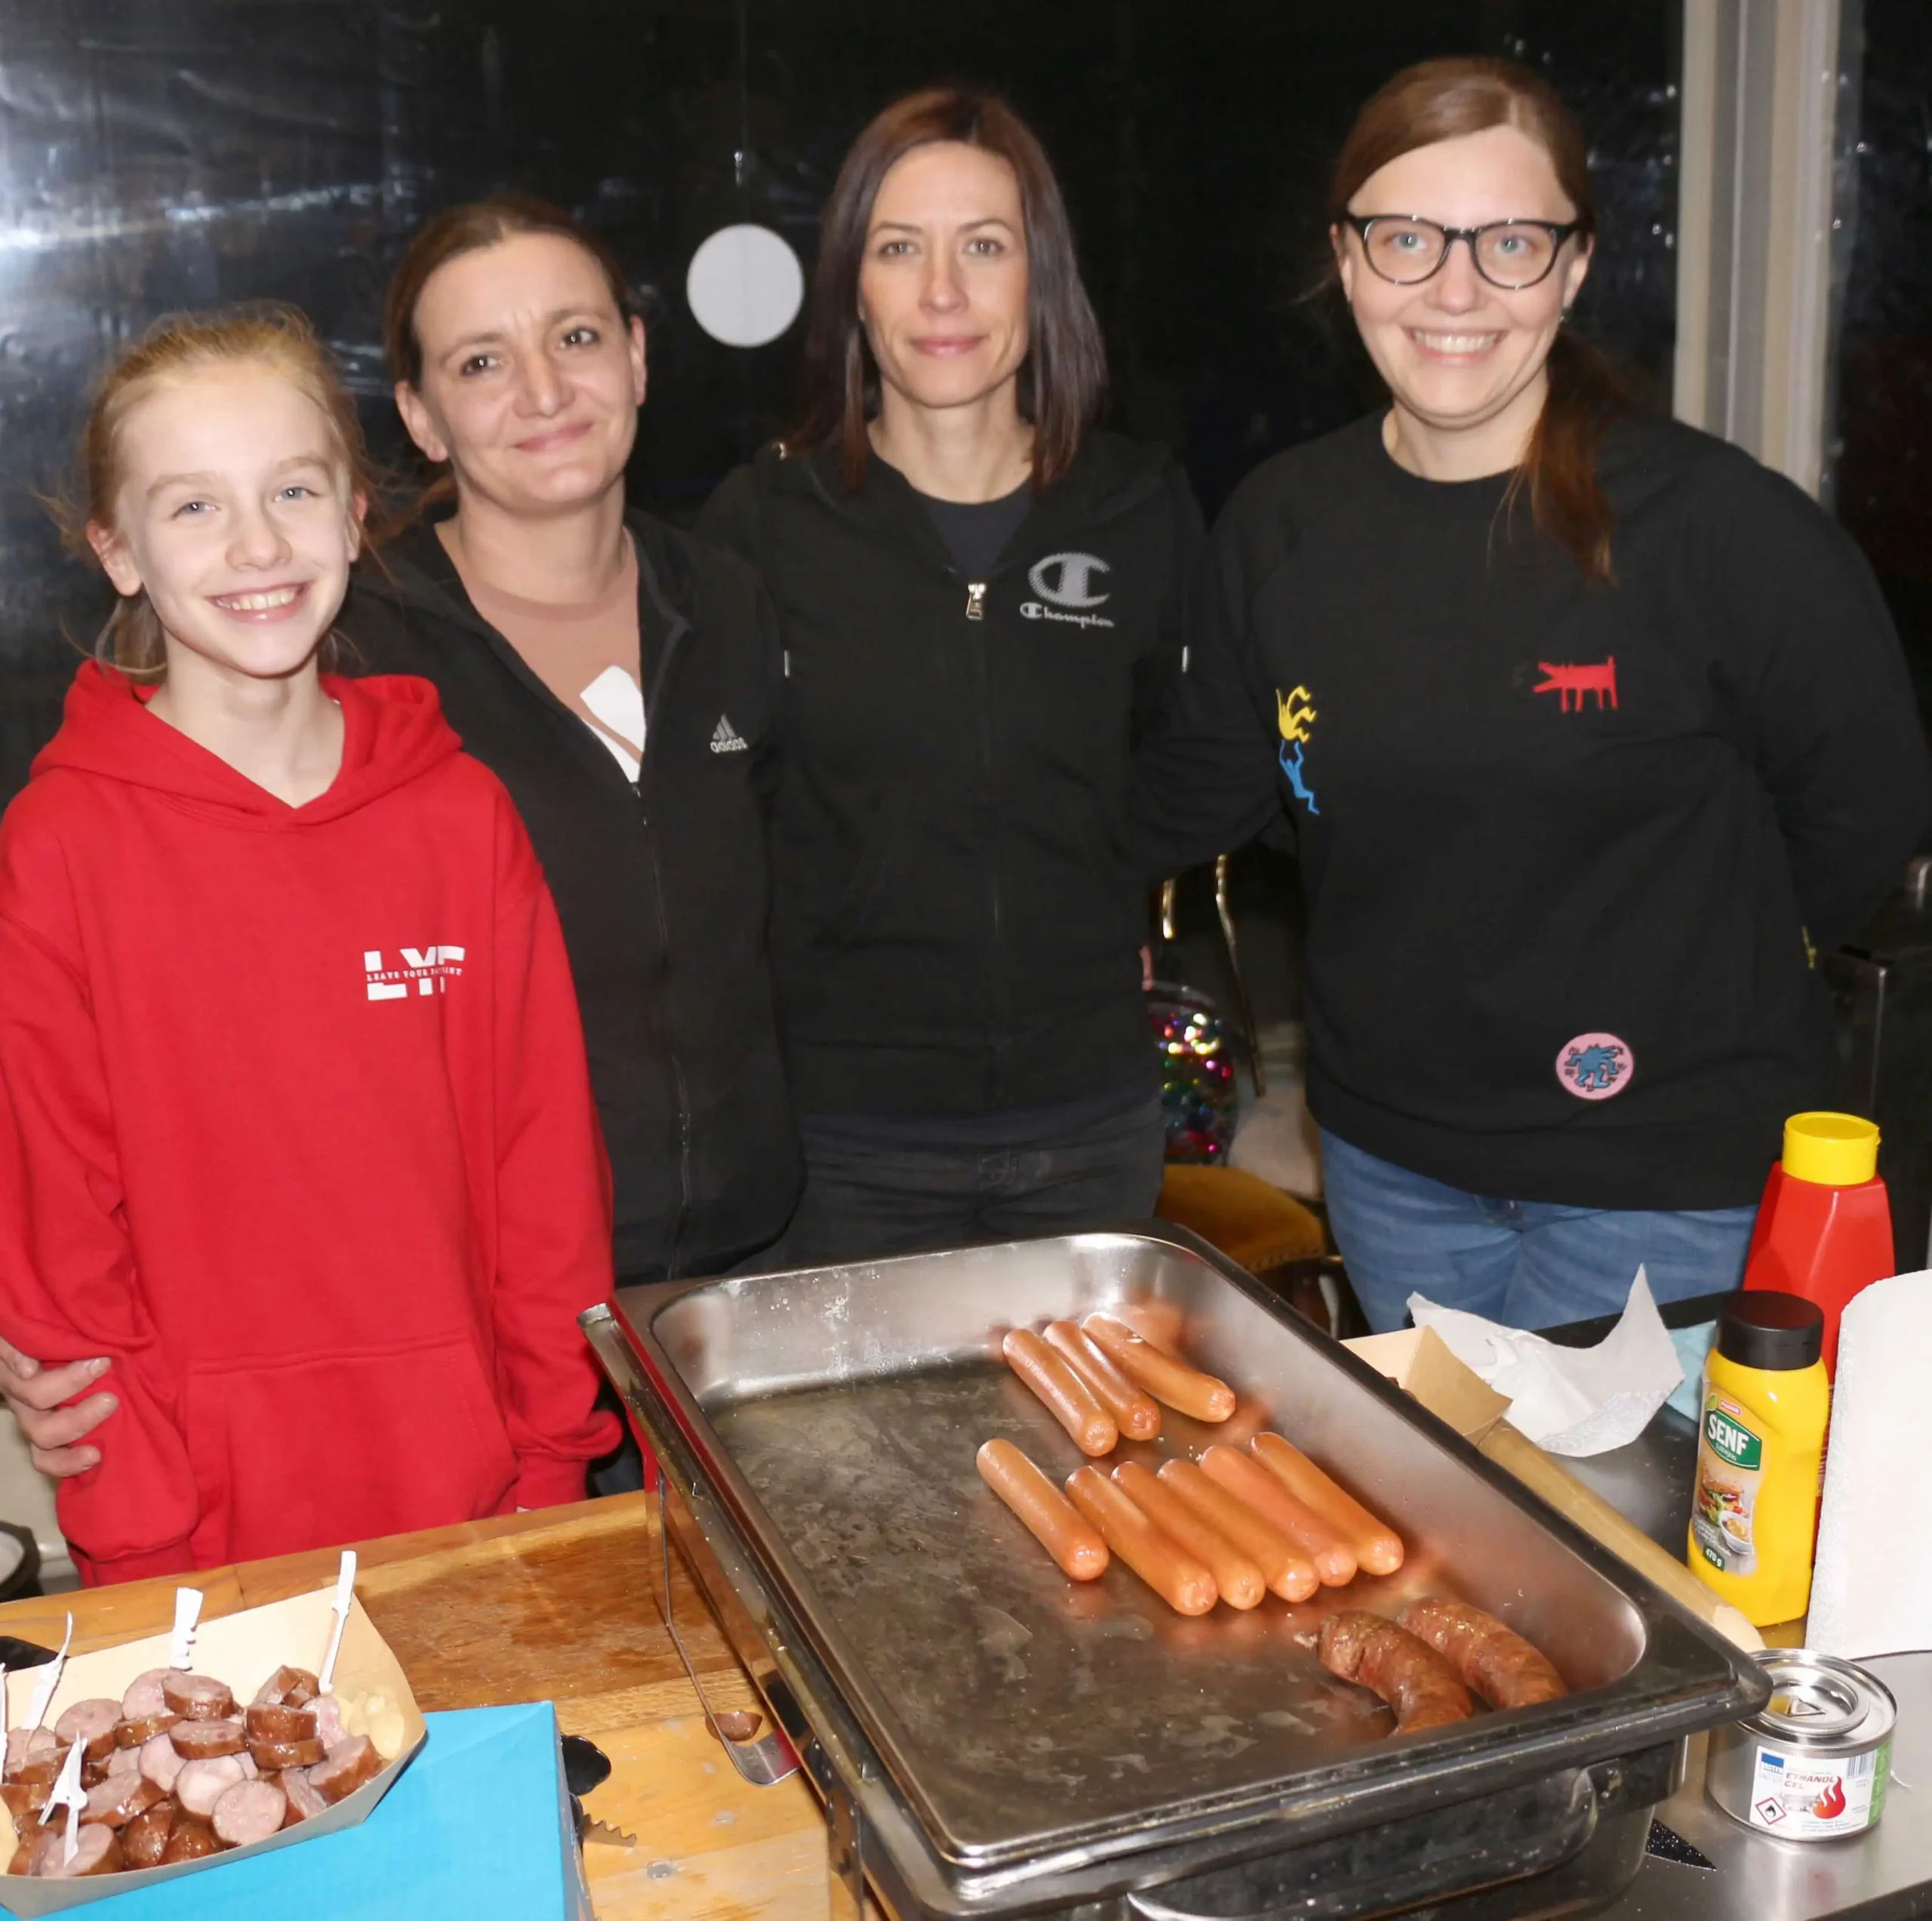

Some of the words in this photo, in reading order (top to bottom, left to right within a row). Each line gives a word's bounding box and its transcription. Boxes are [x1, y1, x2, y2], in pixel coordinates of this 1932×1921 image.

[710, 737, 748, 753] adidas
[366, 971, 400, 982] LEAVE
[402, 968, 429, 979] YOUR
[1708, 1413, 1749, 1455] SENF
[1706, 1548, 1717, 1562] 470
[1716, 1557, 1722, 1567] g
[1786, 1772, 1835, 1784] ETHANOL
